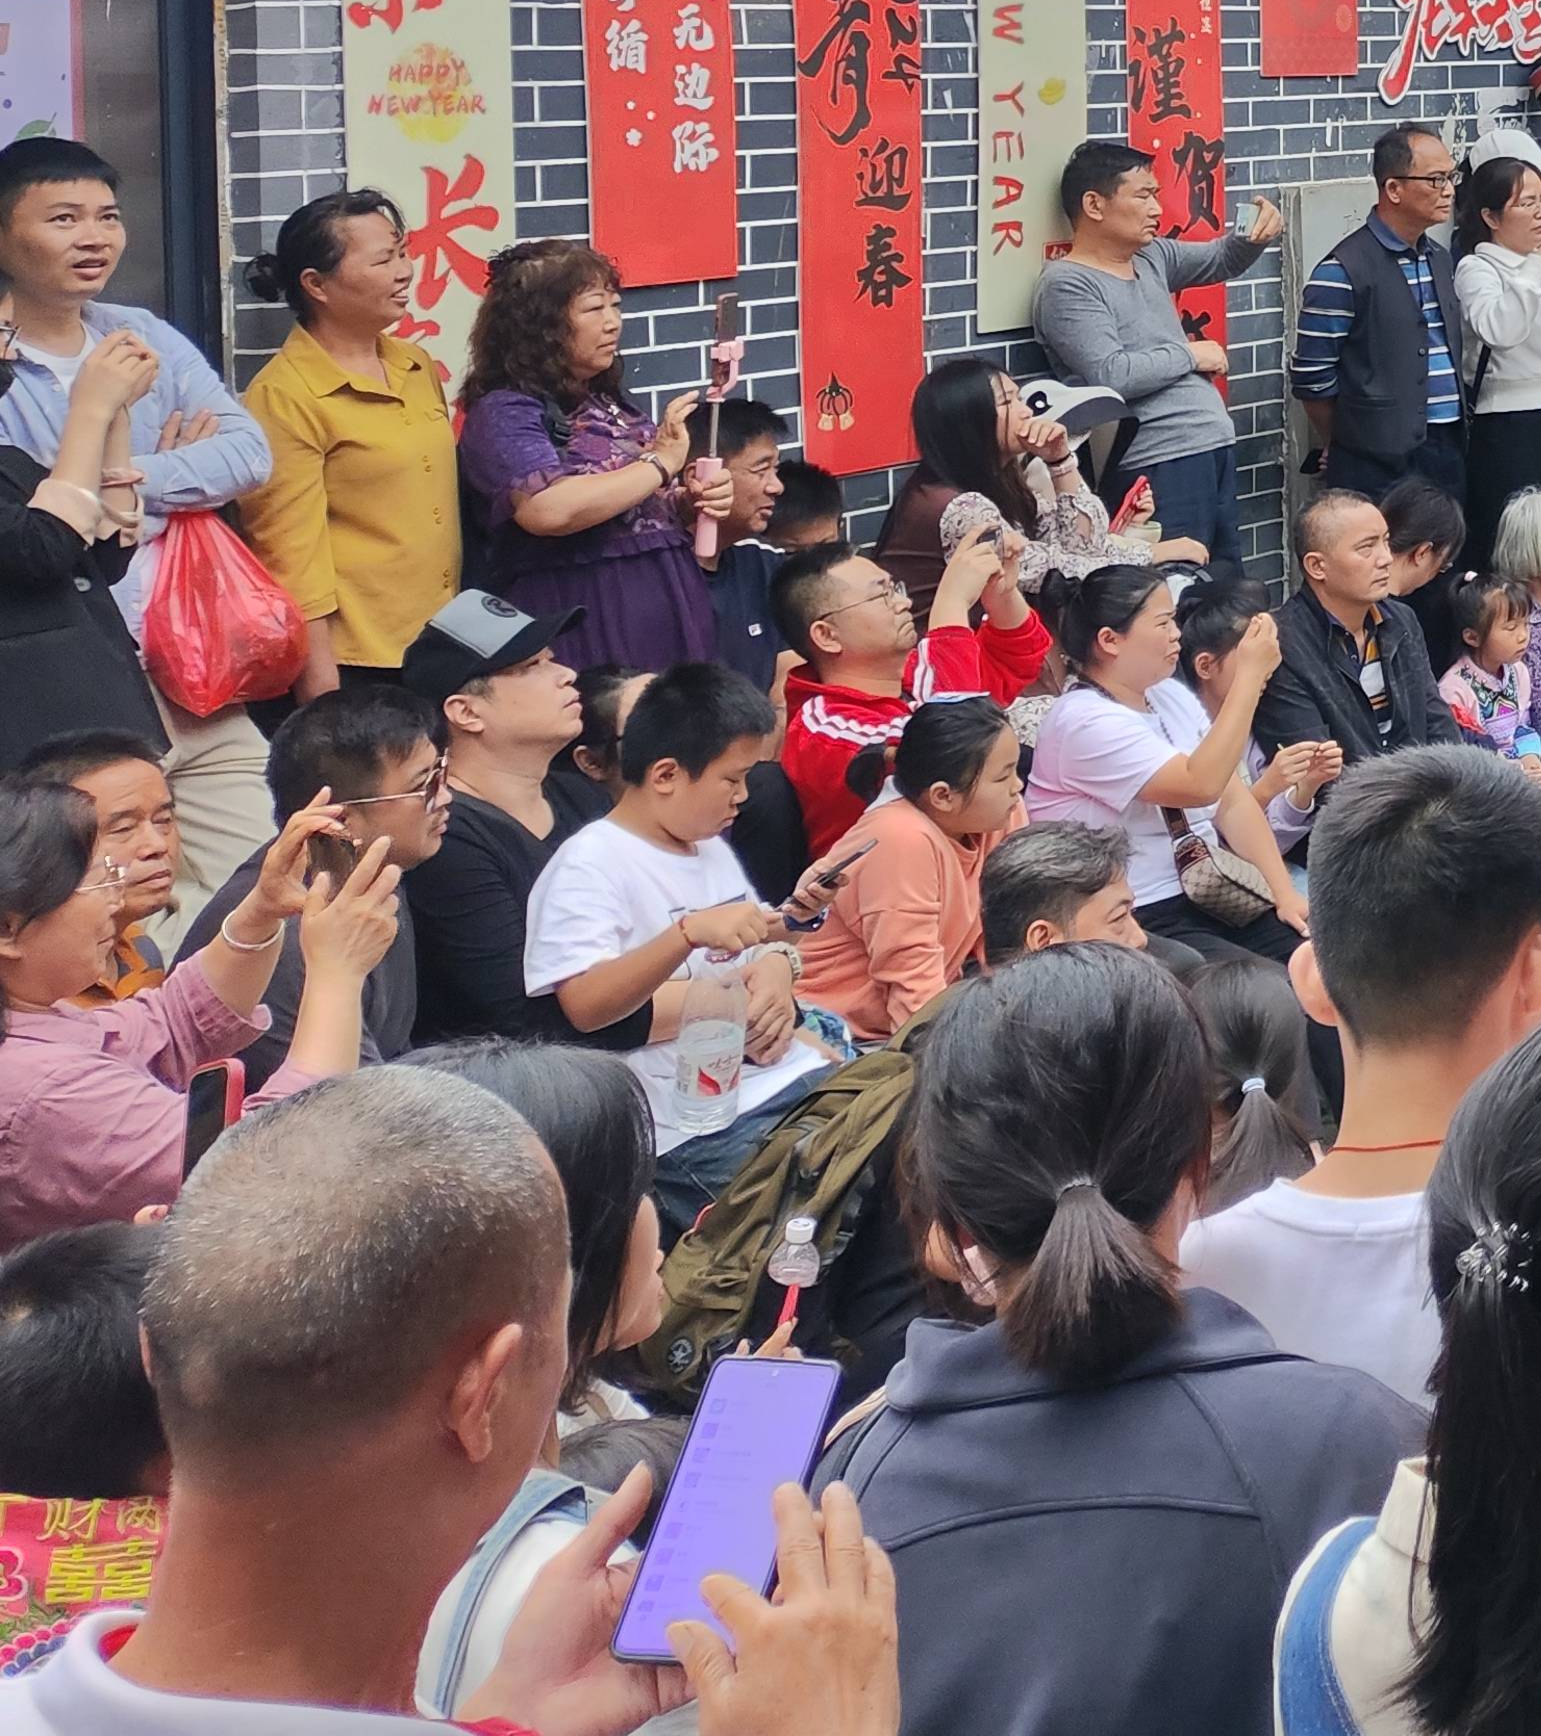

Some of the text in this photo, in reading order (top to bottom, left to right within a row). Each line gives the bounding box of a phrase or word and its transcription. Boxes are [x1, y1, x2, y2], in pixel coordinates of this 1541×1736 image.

[388, 57, 472, 86] HAPPY
[367, 88, 487, 117] NEW YEAR
[991, 80, 1026, 256] YEAR
